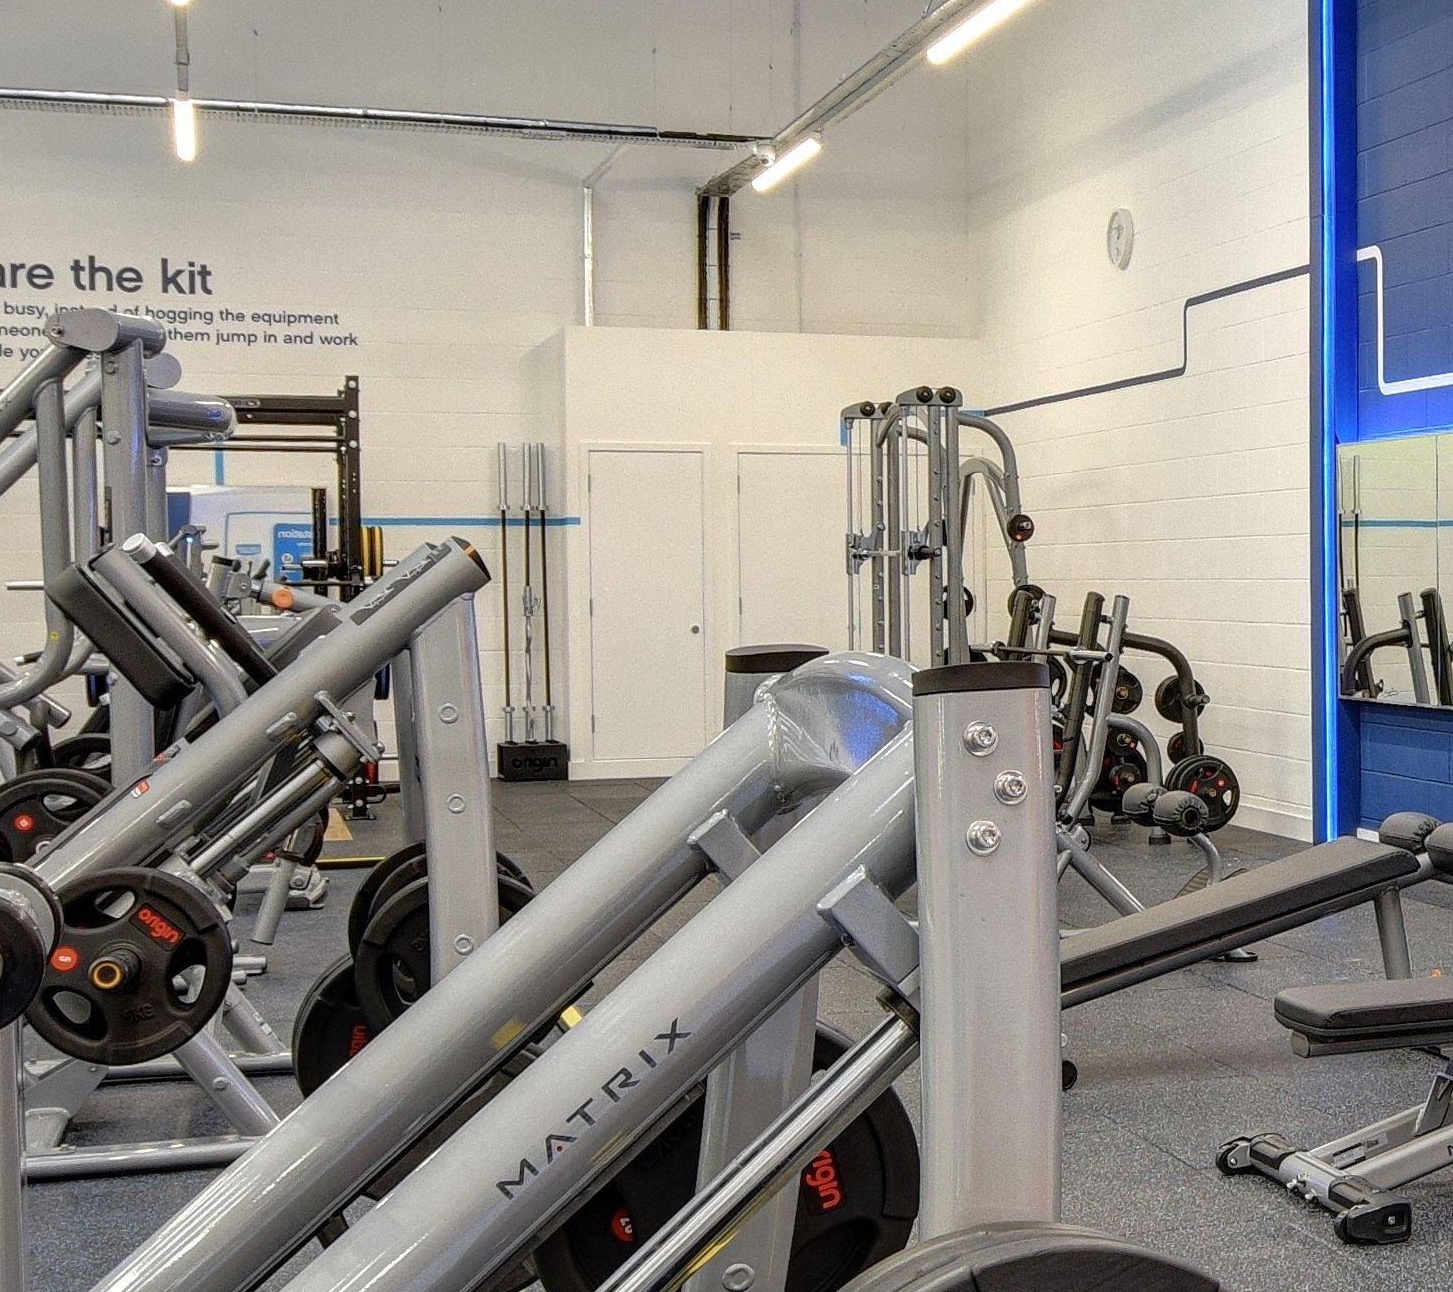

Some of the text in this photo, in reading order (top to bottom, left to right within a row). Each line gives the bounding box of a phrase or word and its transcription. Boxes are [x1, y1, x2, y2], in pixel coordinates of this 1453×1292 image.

[70, 255, 144, 293] the
[160, 257, 213, 296] kit
[4, 302, 49, 320] busy,
[145, 306, 214, 325] hogging
[220, 309, 245, 322] the
[251, 311, 339, 327] equipment
[168, 329, 210, 342] them
[216, 330, 258, 346] jump
[264, 332, 277, 343] in
[283, 333, 313, 345] and
[319, 334, 358, 346] work
[138, 908, 179, 943] origin
[494, 1016, 693, 1202] MATRIX
